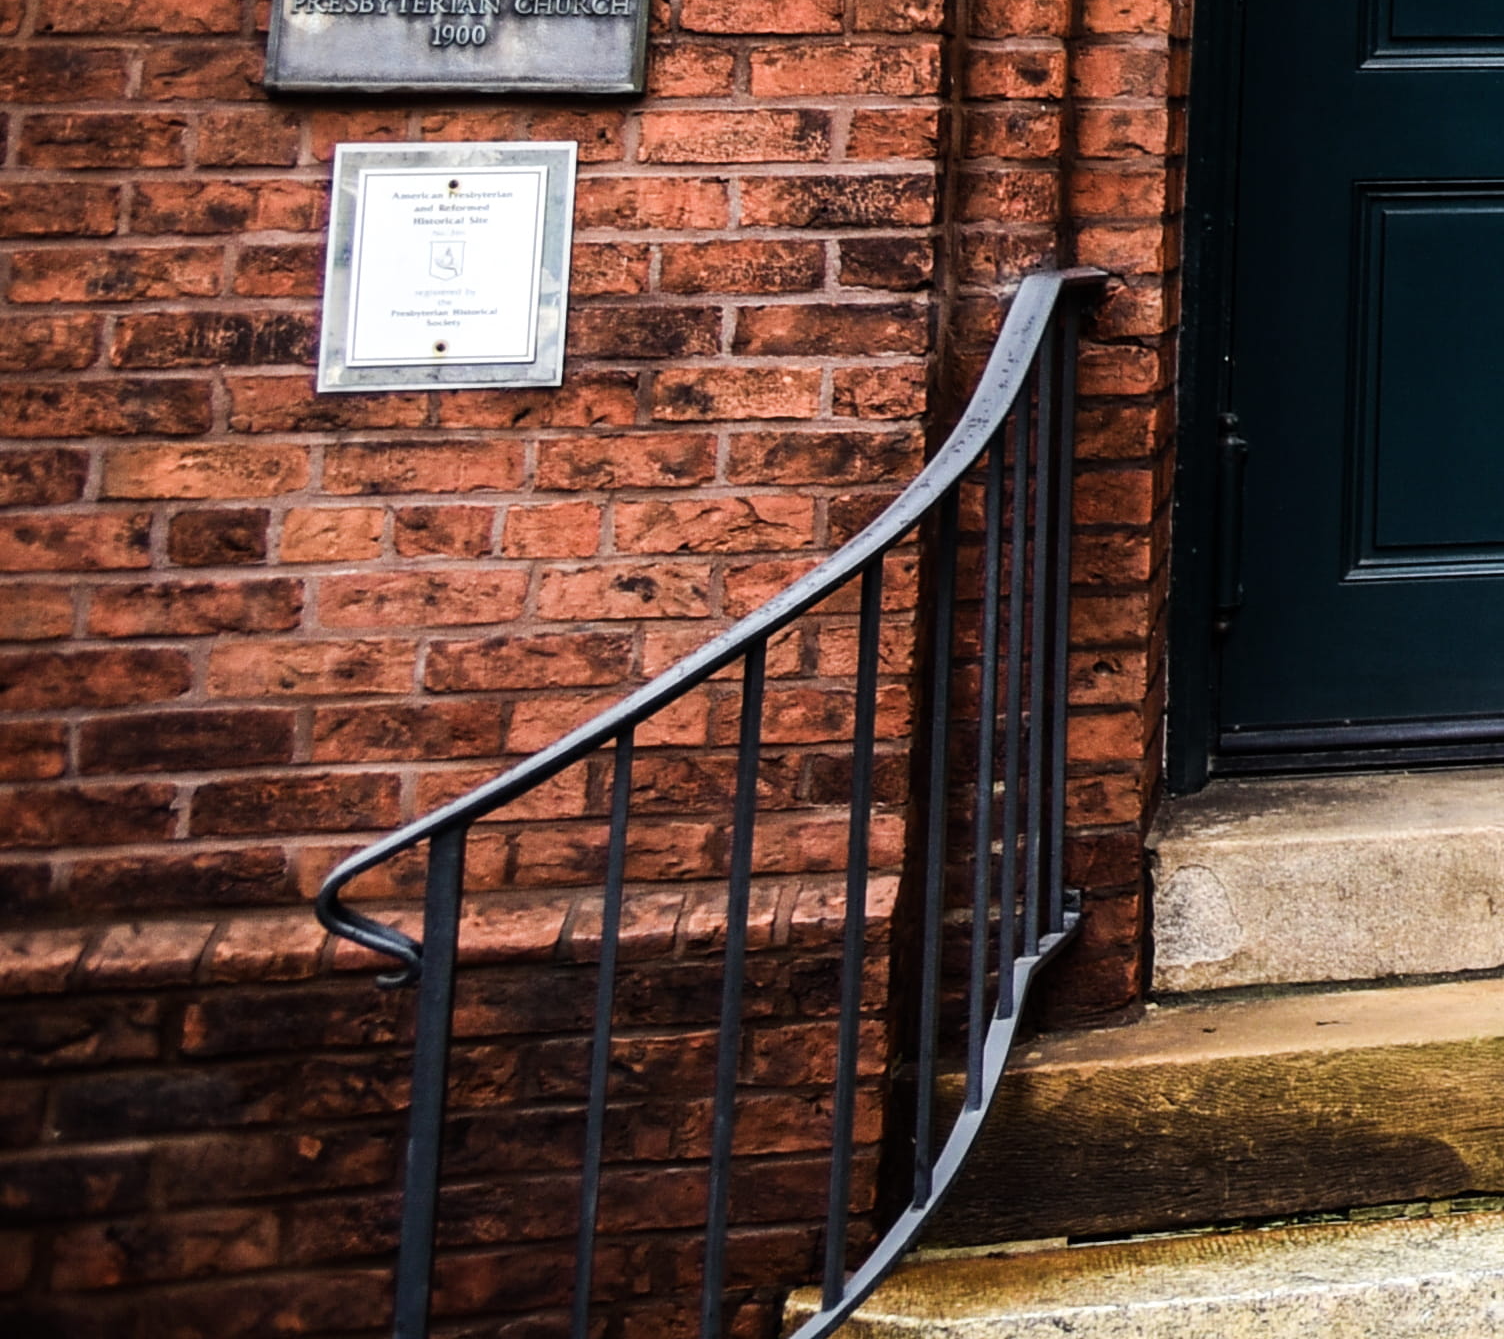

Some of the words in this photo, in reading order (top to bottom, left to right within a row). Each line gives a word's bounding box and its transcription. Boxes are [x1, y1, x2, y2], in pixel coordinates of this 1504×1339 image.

[431, 25, 486, 46] 1900
[449, 191, 512, 200] Presbyterian
[413, 217, 464, 225] Historical
